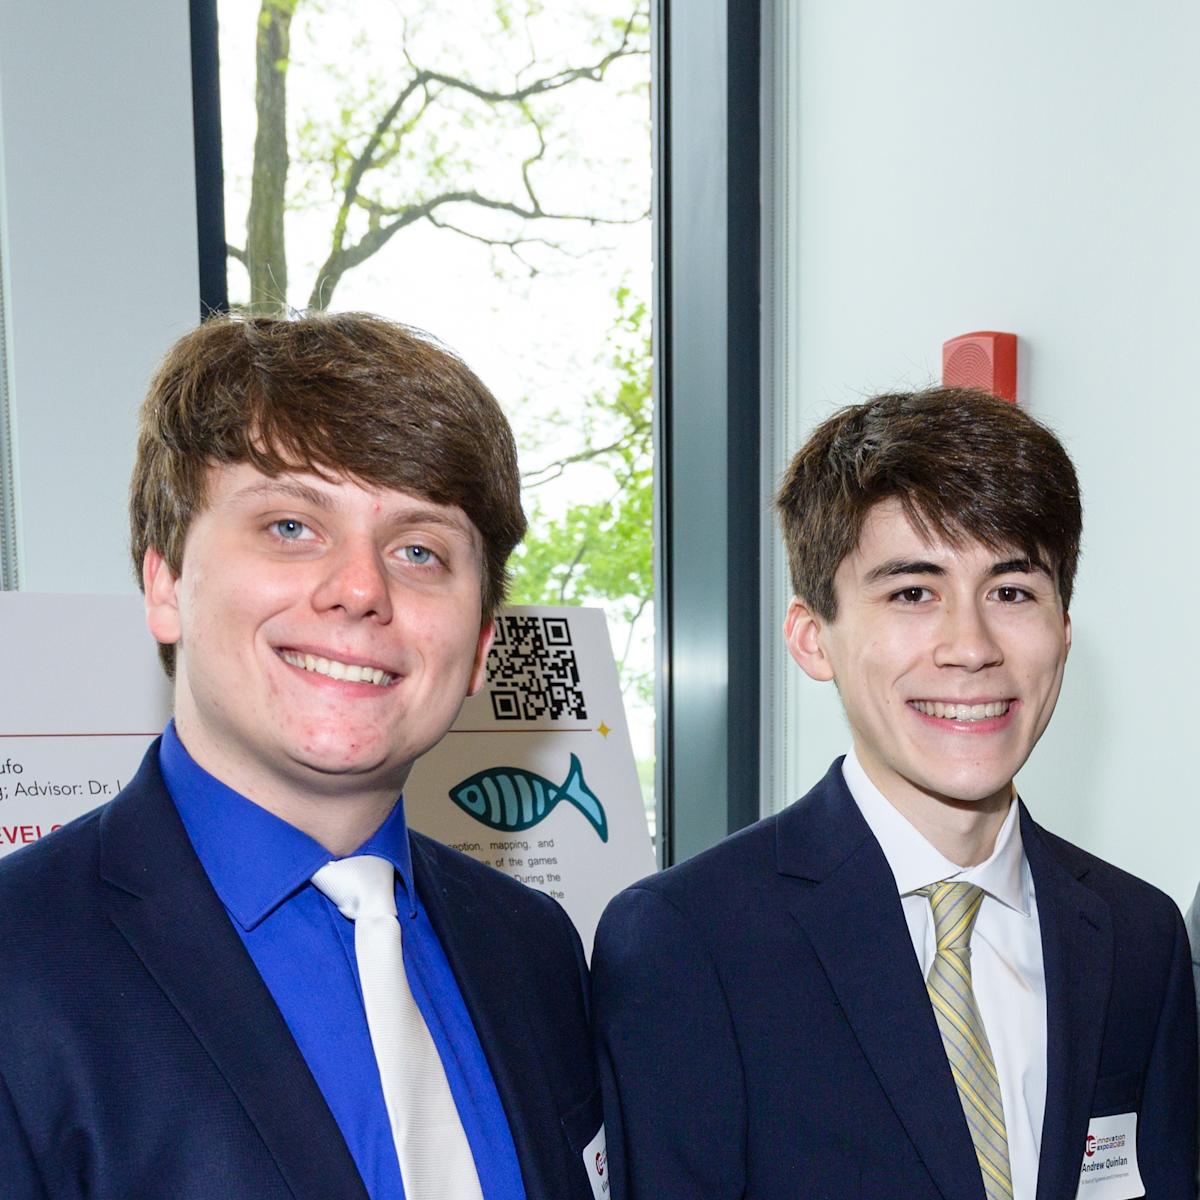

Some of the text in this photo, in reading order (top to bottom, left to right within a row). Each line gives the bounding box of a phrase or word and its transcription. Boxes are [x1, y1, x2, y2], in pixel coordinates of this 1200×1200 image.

[15, 780, 83, 797] Advisor:
[88, 780, 111, 795] Dr.
[490, 841, 531, 851] mapping,
[538, 839, 554, 848] and
[496, 858, 505, 868] of
[509, 858, 523, 867] the
[528, 858, 558, 868] games
[514, 873, 561, 885] During the
[1082, 1157, 1128, 1173] Andrew Quinlan
